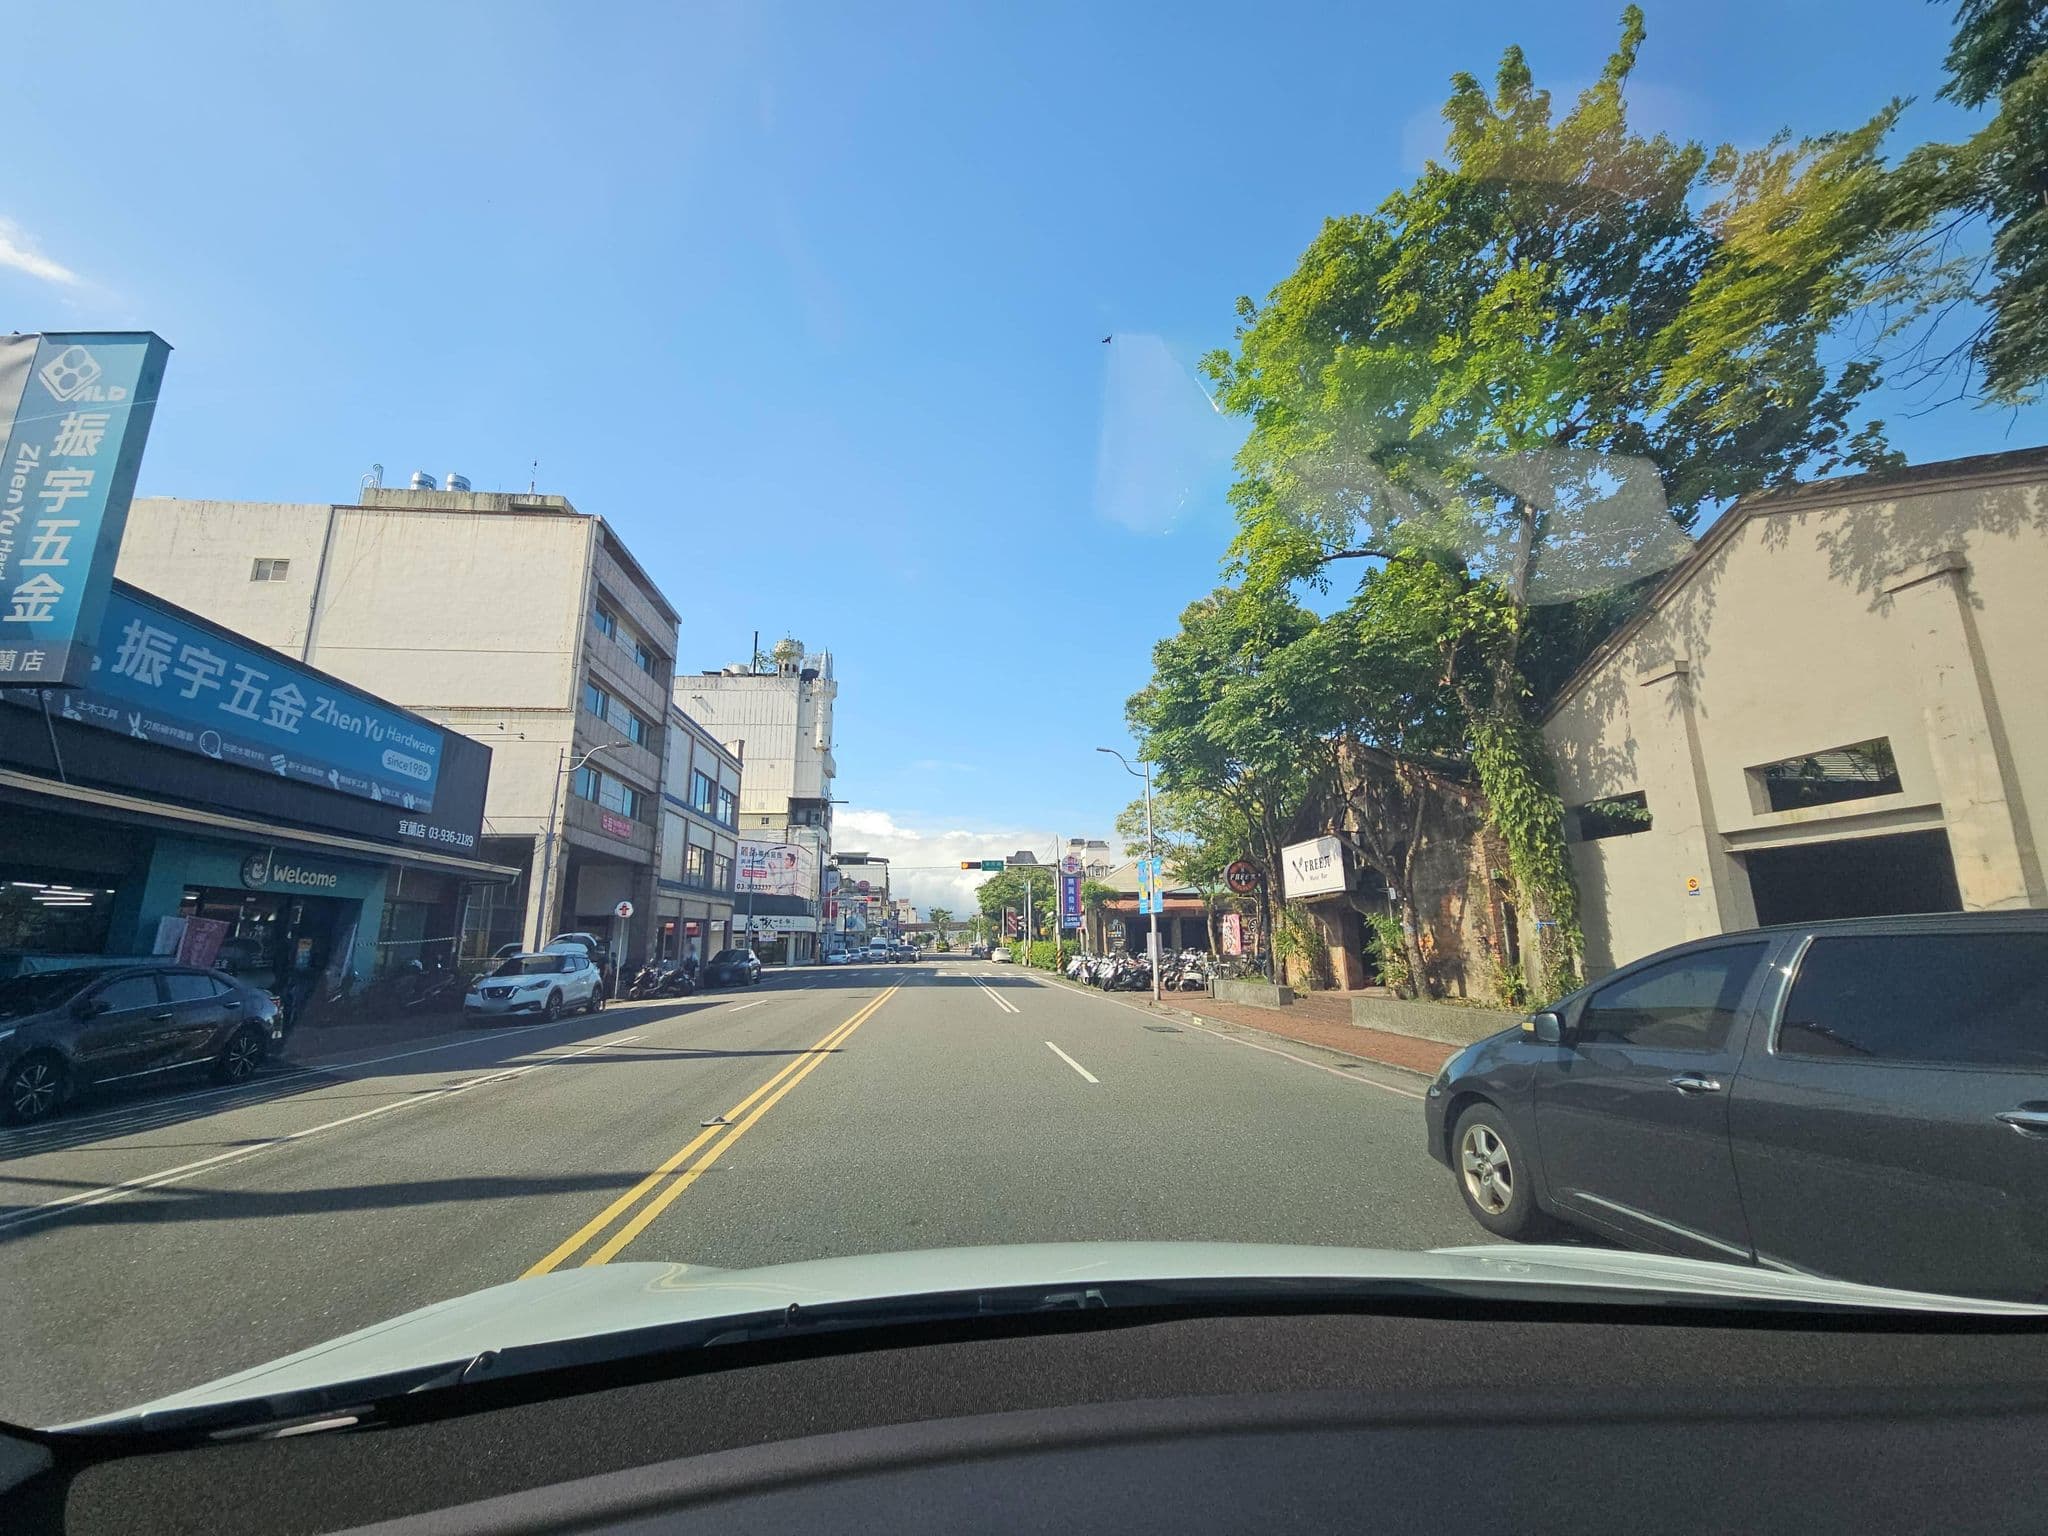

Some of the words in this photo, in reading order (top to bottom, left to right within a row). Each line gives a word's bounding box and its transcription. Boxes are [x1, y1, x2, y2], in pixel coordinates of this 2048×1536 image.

[3, 411, 111, 622] 振宇五金
[111, 617, 307, 735] 振宇五金
[386, 725, 436, 755] Hardware
[398, 819, 426, 838] 宜蘭店
[428, 826, 474, 848] 03-936-2189
[273, 863, 337, 888] Welcome
